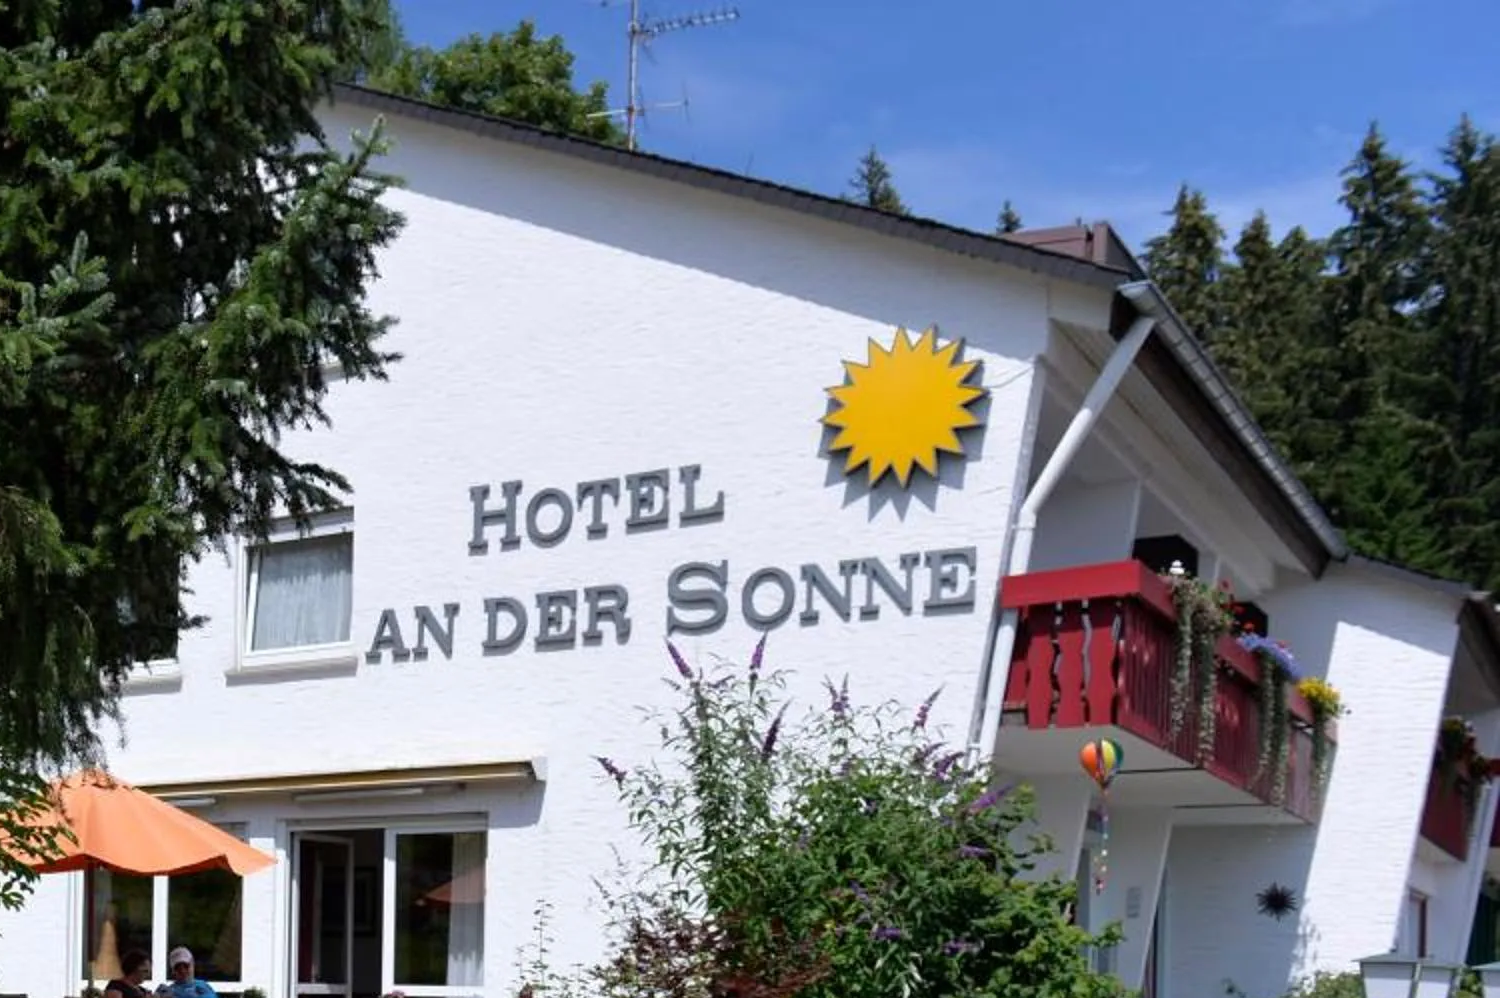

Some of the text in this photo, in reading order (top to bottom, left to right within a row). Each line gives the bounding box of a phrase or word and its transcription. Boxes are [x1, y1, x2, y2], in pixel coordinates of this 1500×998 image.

[469, 464, 724, 554] HOTEL
[366, 546, 976, 663] AN DER SONNE
